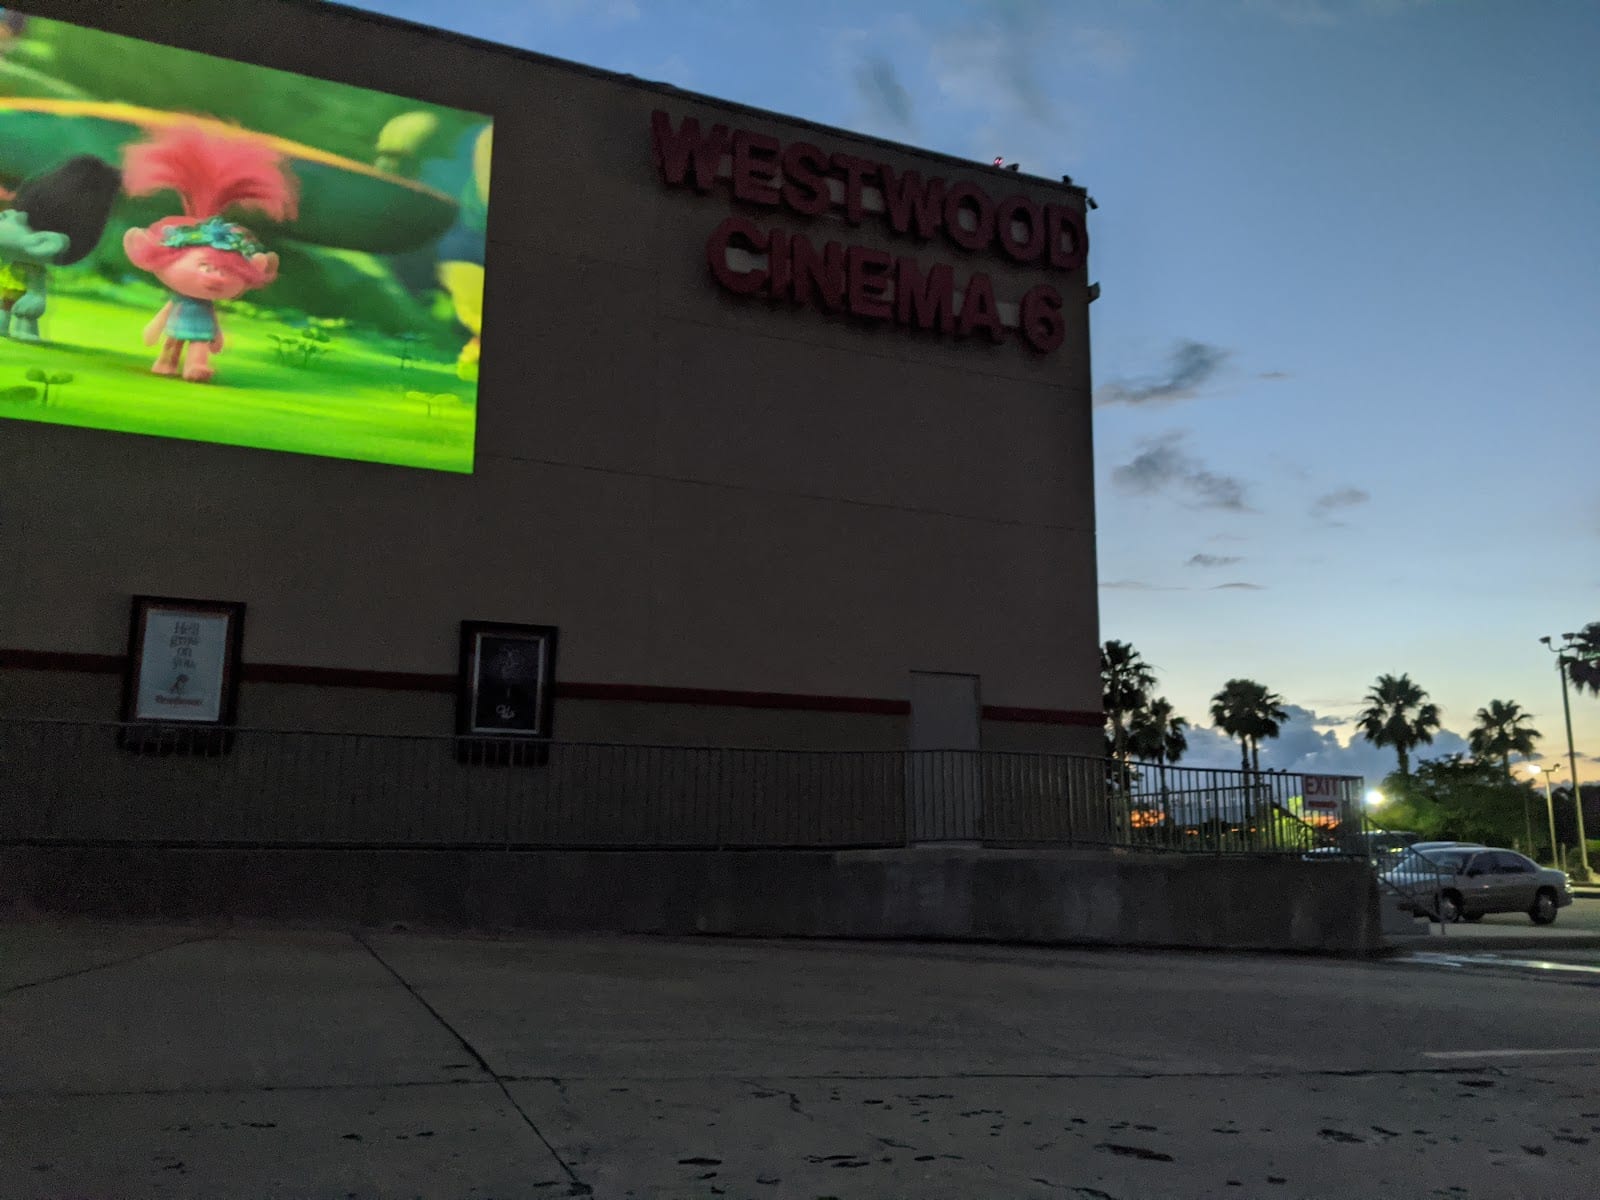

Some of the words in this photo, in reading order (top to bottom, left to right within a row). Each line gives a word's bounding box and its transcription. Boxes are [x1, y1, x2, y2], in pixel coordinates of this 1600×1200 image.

[652, 111, 1088, 271] WESTWOOD
[707, 217, 1009, 344] CINEMA
[1020, 285, 1065, 355] 6
[1305, 776, 1338, 796] EXIT
